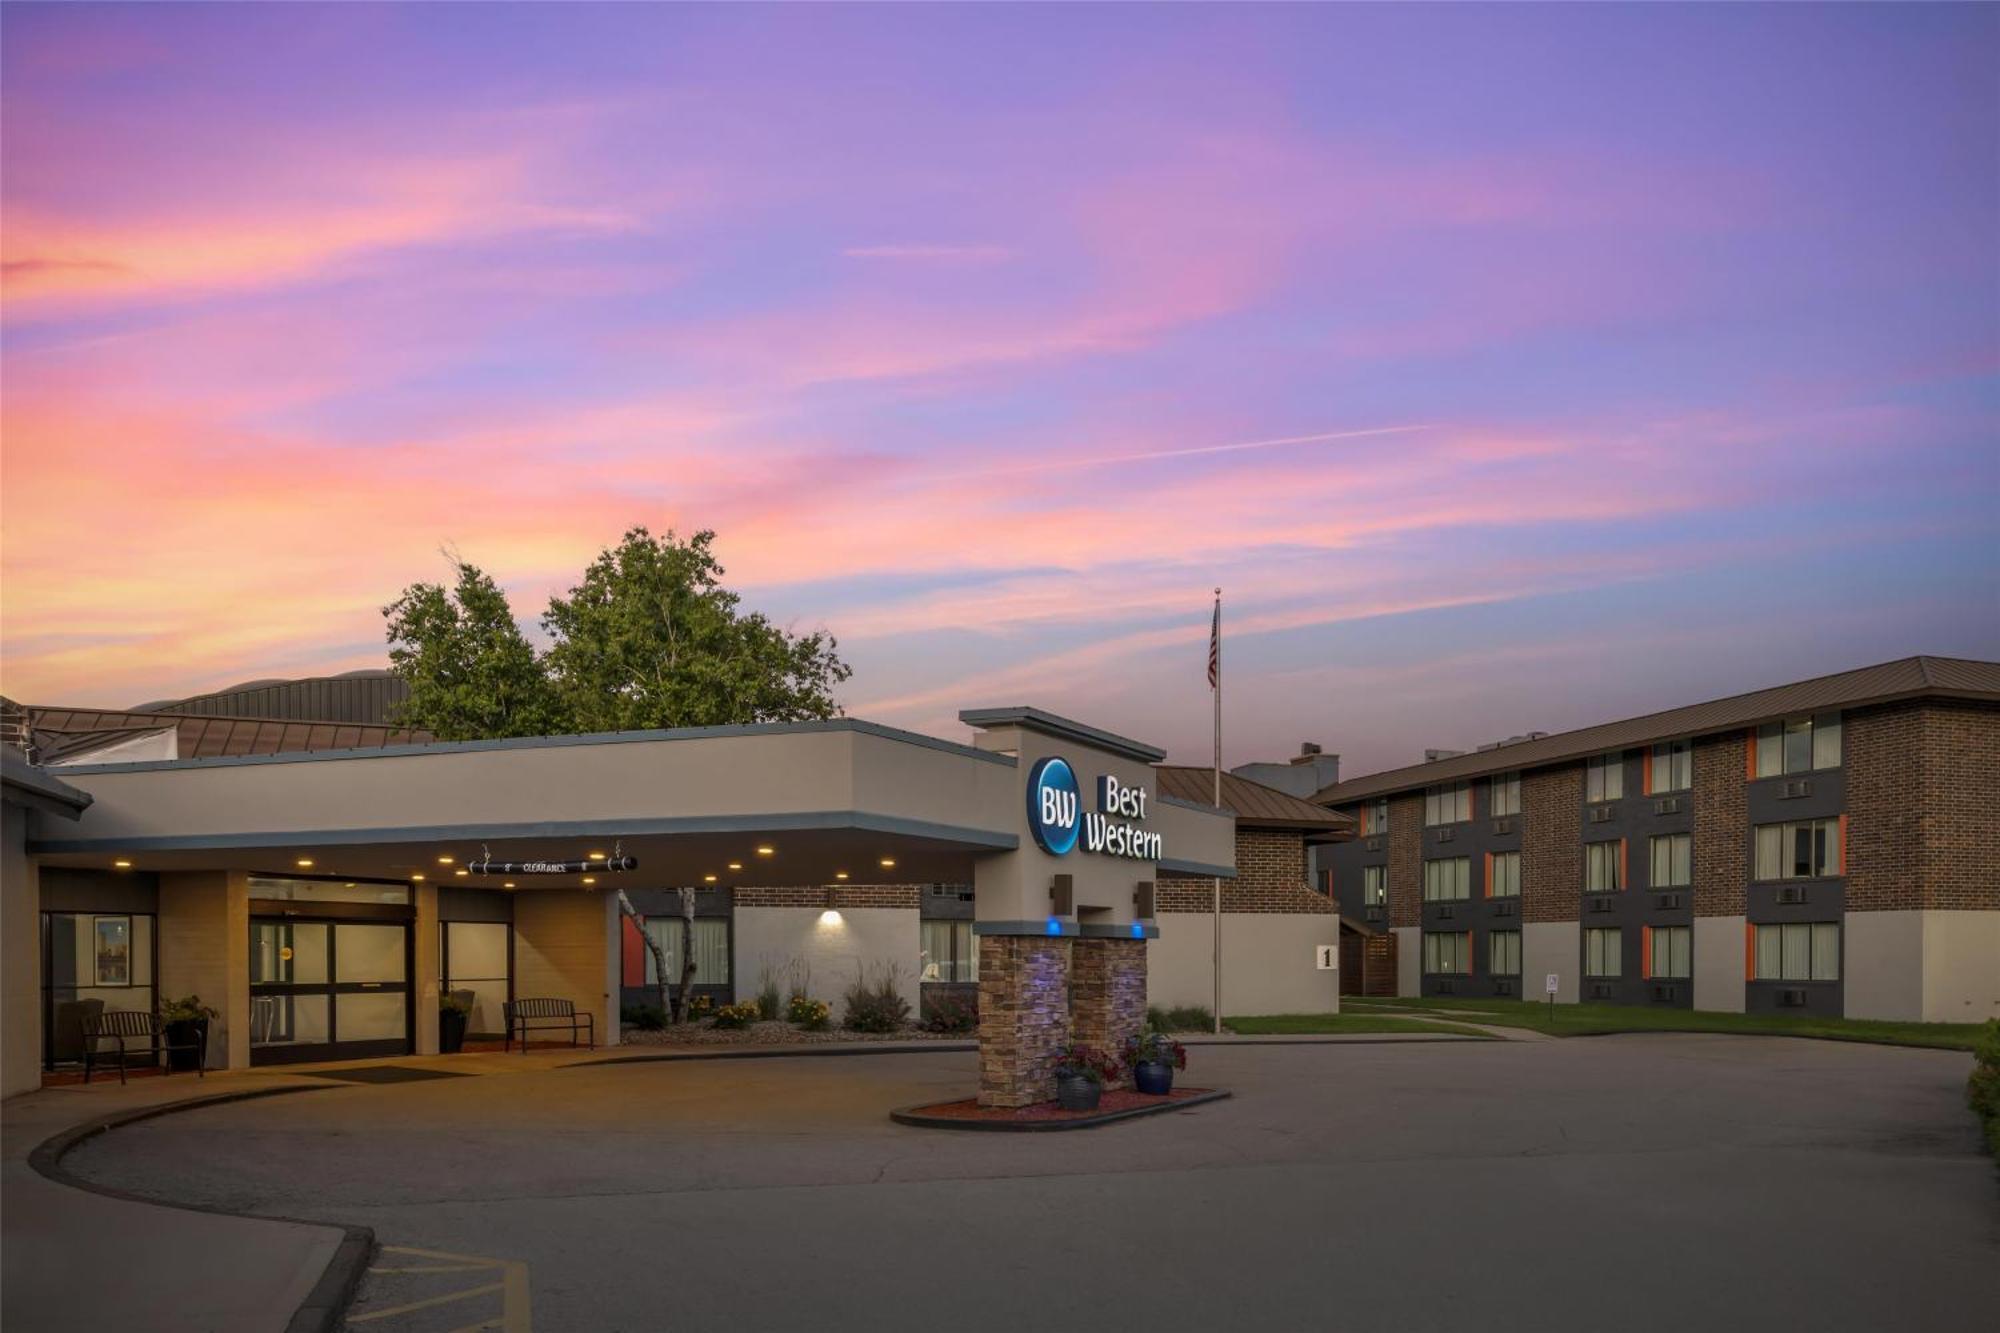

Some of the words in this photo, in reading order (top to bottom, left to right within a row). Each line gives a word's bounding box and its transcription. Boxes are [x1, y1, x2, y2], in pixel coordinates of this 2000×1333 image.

[1042, 786, 1076, 828] BW
[1106, 775, 1147, 819] Best
[1086, 812, 1161, 860] Western
[523, 863, 566, 872] CLEARANCE
[1324, 948, 1330, 967] 1
